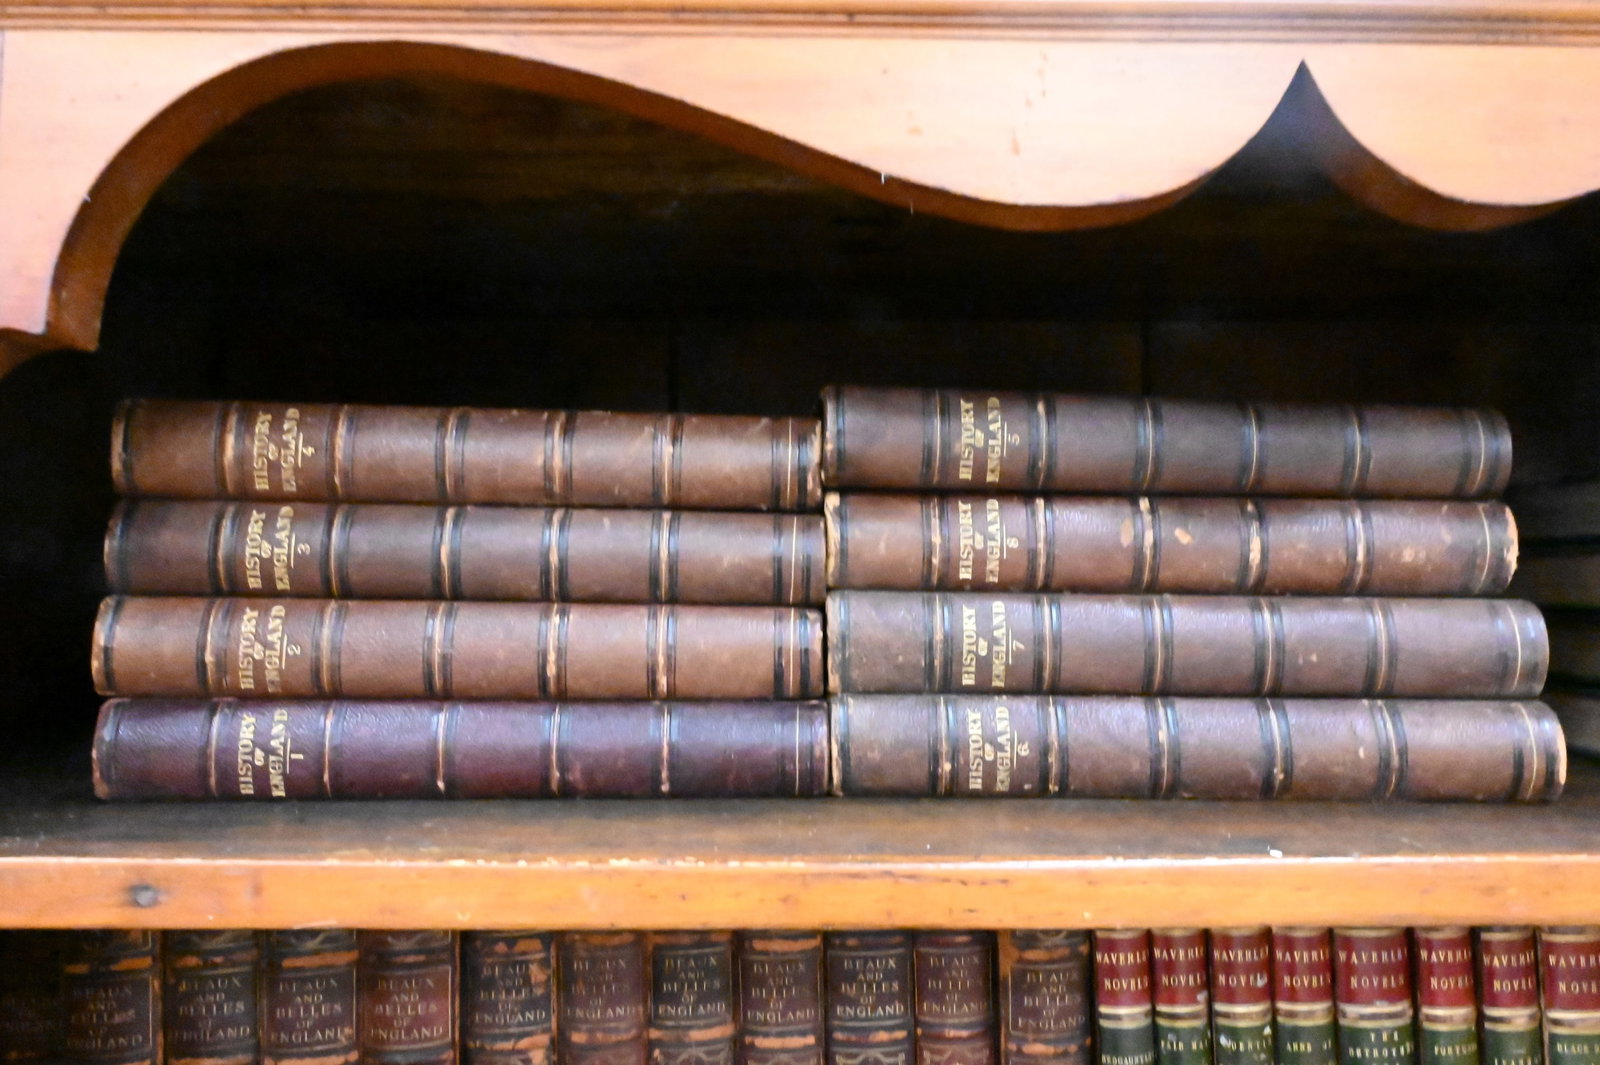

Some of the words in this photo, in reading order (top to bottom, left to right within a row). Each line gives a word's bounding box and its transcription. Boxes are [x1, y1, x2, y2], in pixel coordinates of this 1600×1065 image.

[253, 410, 272, 490] HISTORY
[281, 408, 300, 492] ENGLAND
[302, 446, 315, 457] 4
[959, 398, 974, 481] HISTORY
[986, 397, 1001, 483] ENGLAND
[1008, 433, 1020, 446] 5
[245, 509, 266, 590] HISTORY
[273, 506, 294, 591] ENGLAND
[297, 542, 311, 555] 3
[958, 500, 973, 580] HISTORY
[986, 499, 1001, 583] ENGLAND
[1007, 537, 1019, 549] 8
[239, 606, 259, 690] HISTORY
[265, 605, 286, 693] ENGLAND
[288, 644, 301, 656] 2
[962, 604, 976, 686] HISTORY
[992, 601, 1006, 688] ENGLAND
[1013, 639, 1025, 651] 7
[238, 711, 256, 795] HISTORY
[269, 709, 288, 797] ENGLAND
[967, 708, 983, 790] HISTORY
[995, 706, 1011, 793] ENGLAND
[1096, 949, 1148, 965] WAVERLE
[1162, 972, 1206, 987] NOVEL
[1549, 954, 1600, 969] WAVER
[836, 1001, 905, 1018] ENGLAND
